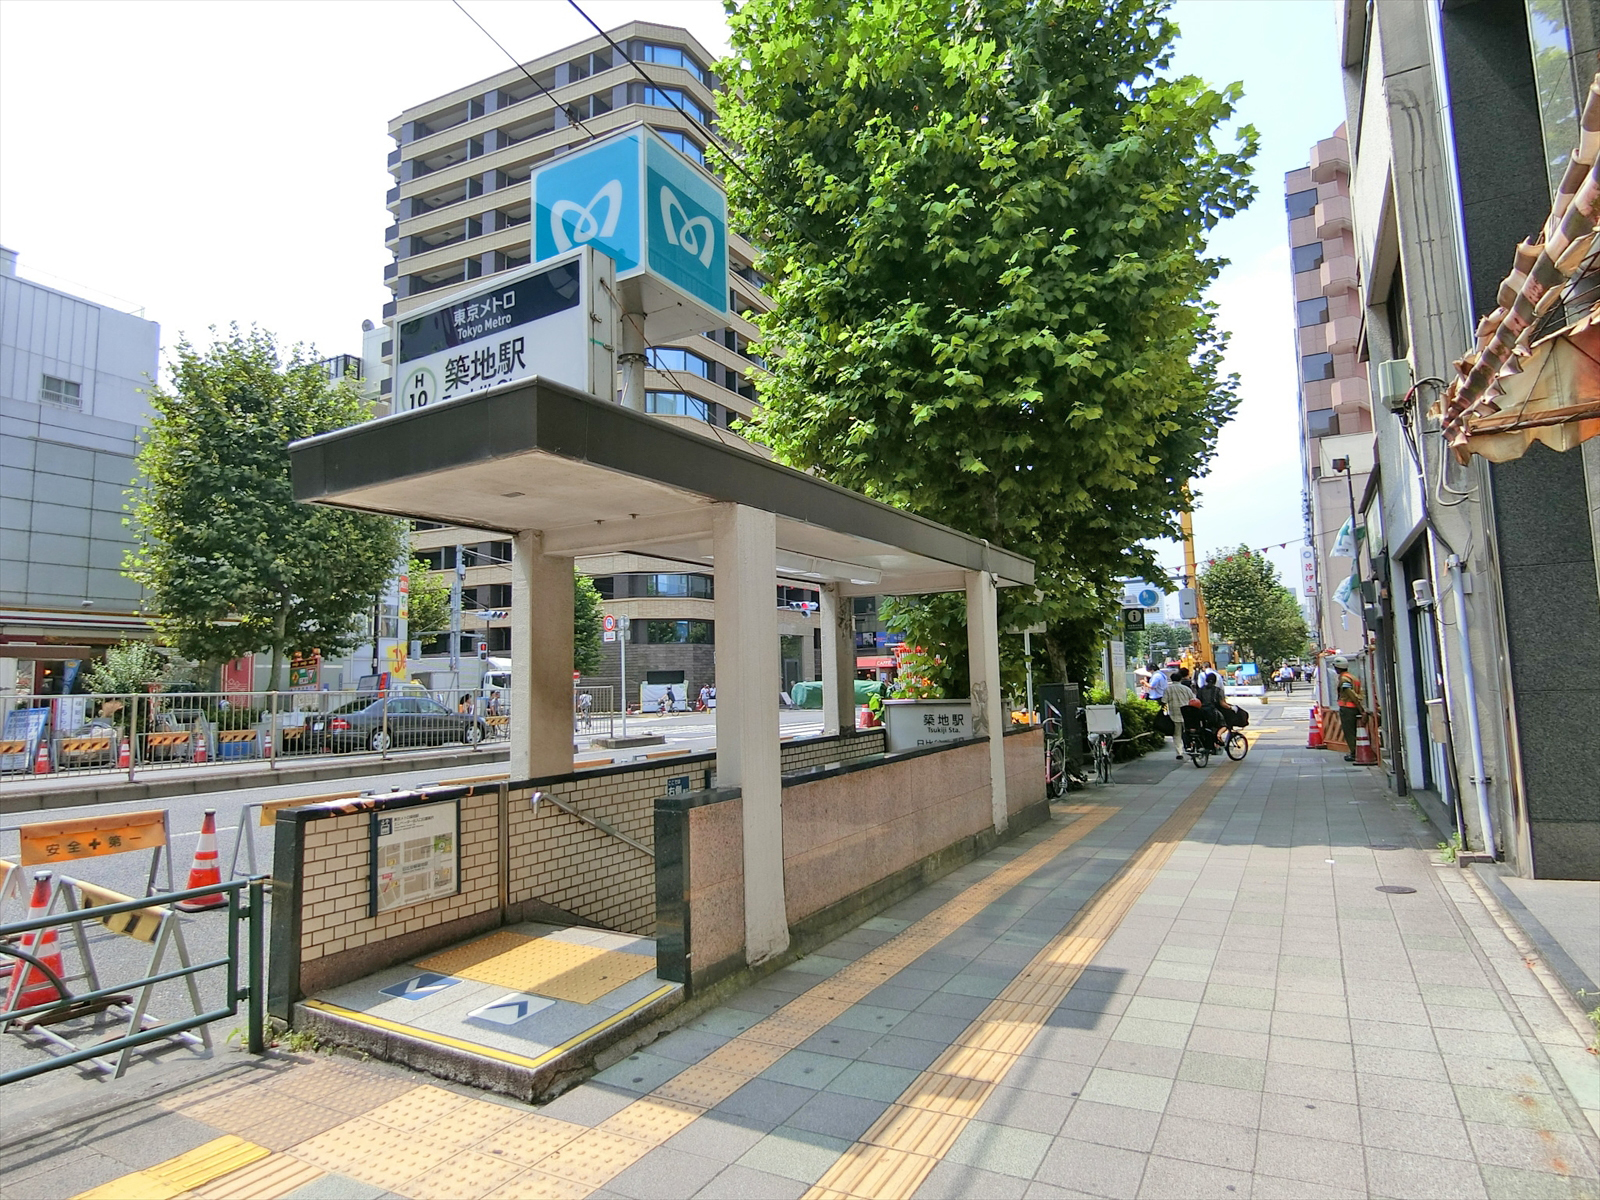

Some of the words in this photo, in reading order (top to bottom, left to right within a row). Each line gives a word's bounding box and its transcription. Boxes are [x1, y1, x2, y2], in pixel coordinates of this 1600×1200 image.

[453, 290, 516, 327] 東京メトロ
[457, 322, 483, 340] Tokyo
[484, 313, 512, 331] Metro
[444, 336, 527, 392] 築地駅
[415, 373, 424, 388] H
[409, 390, 428, 409] 10
[923, 713, 964, 726] 築地駅
[927, 727, 947, 735] Tsukiji
